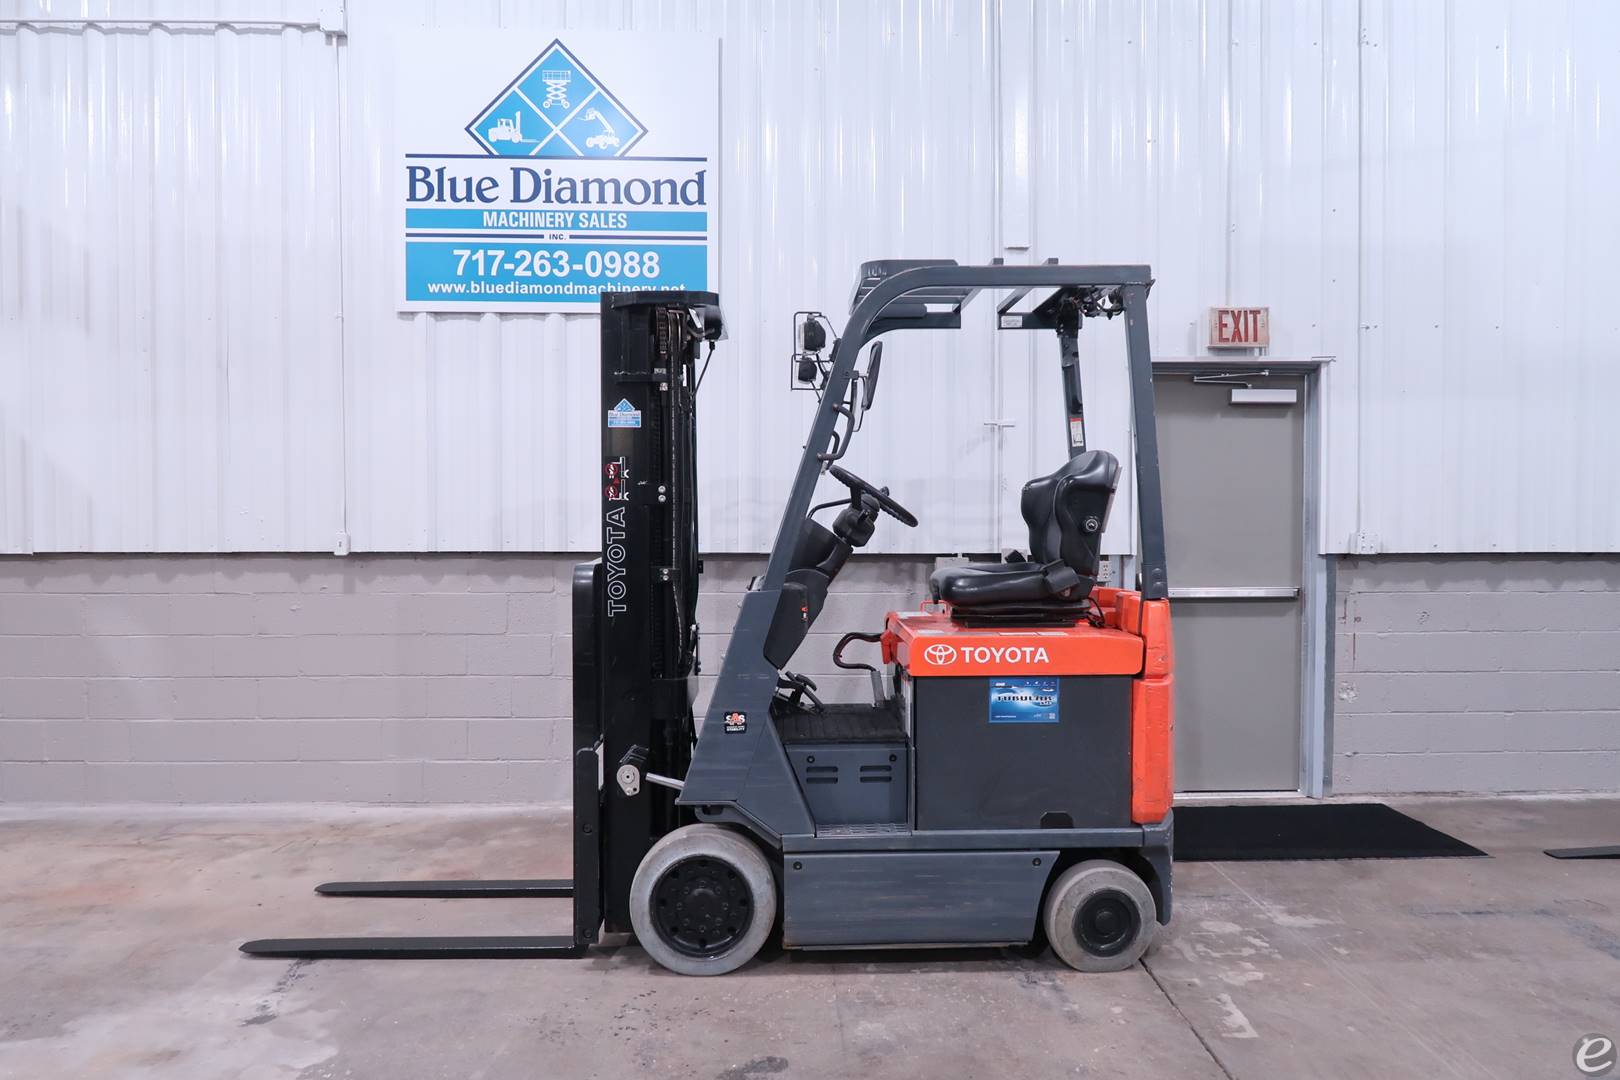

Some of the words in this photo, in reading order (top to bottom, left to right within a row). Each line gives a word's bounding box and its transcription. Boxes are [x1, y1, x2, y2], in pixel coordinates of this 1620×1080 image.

[406, 165, 500, 203] Blue
[509, 167, 707, 206] Diamond
[482, 211, 575, 228] MACHINERY
[578, 212, 628, 229] SALES
[548, 233, 567, 241] INC.
[453, 249, 660, 278] 717-263-0988
[428, 280, 686, 295] www.bluediamondmachinernet
[1218, 310, 1261, 343] EXIT
[606, 506, 627, 617] TOYOTA
[961, 647, 1049, 663] TOYOTA
